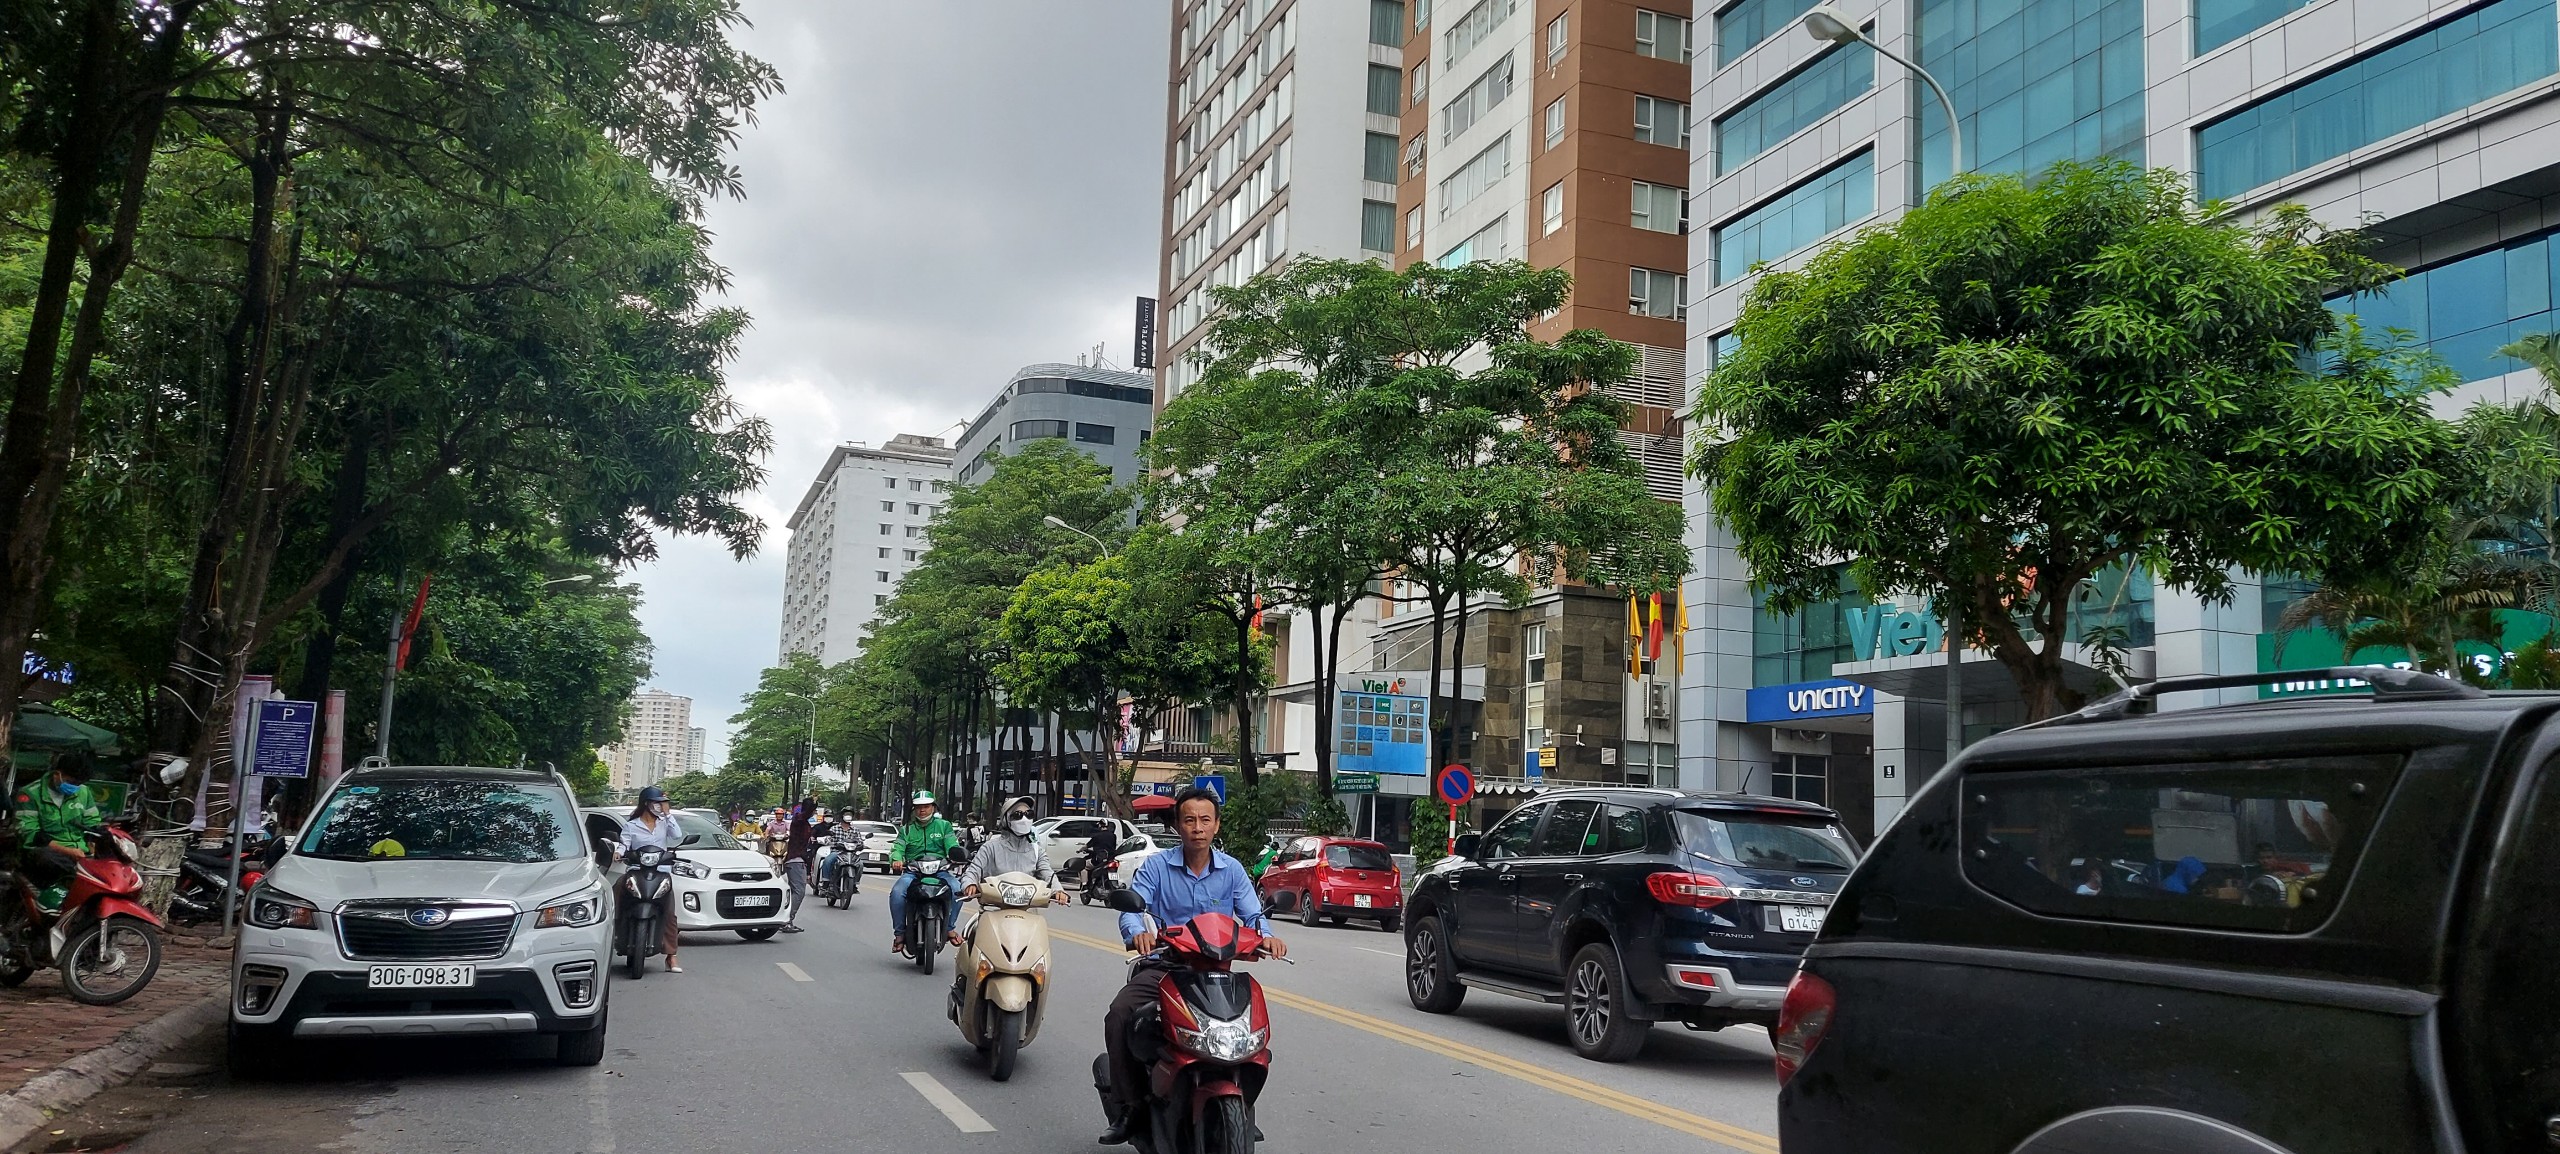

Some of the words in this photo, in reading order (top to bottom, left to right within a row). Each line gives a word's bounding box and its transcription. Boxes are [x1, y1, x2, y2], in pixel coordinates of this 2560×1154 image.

[1140, 324, 1148, 364] NOVOTEL
[1845, 596, 1943, 661] Viet
[1788, 685, 1866, 712] UNICITY
[283, 708, 295, 720] P
[1886, 766, 1892, 775] 9
[1793, 906, 1815, 918] 30H
[1708, 931, 1754, 939] TITANIUM
[371, 967, 470, 985] 30G-098.31
